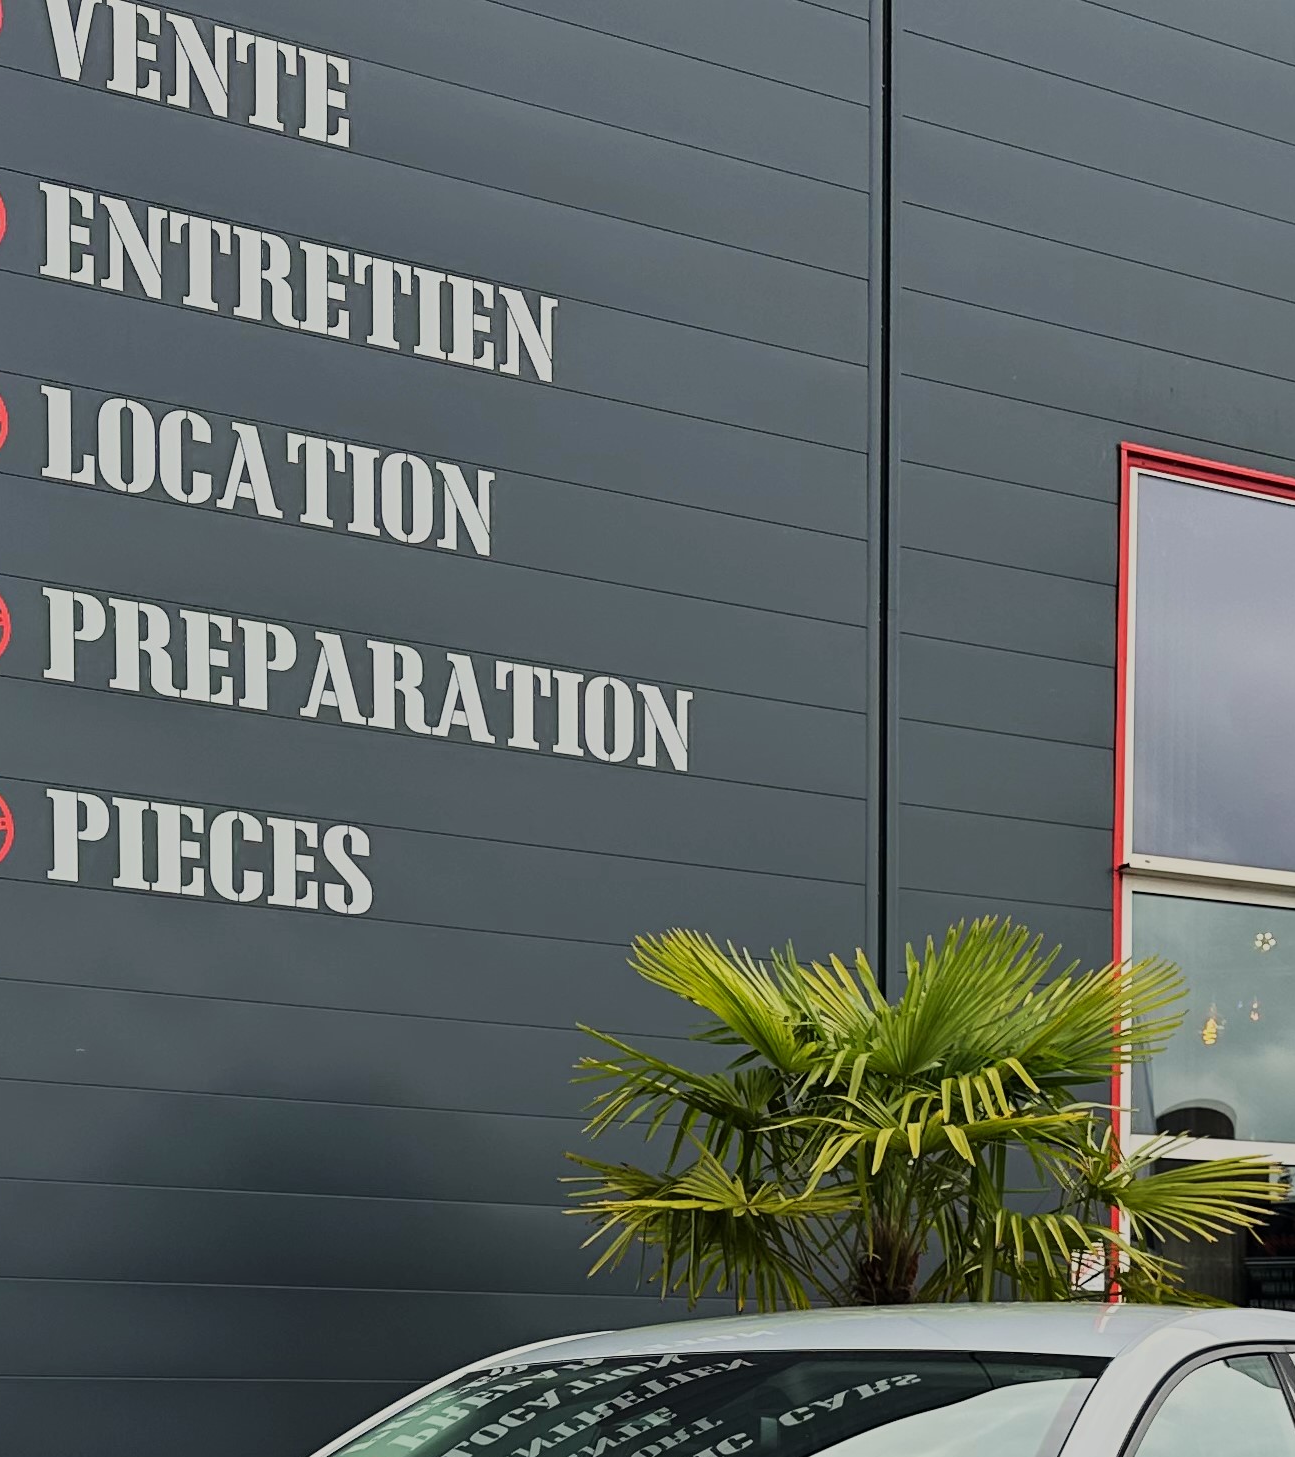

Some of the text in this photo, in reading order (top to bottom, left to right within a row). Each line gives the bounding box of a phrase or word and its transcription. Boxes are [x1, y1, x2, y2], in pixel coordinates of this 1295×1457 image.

[46, 0, 351, 148] VENTE
[38, 180, 559, 384] ENTRETIEN
[40, 384, 496, 557] LOCATION
[42, 586, 694, 773] PREPARATION
[46, 787, 374, 915] PIECES
